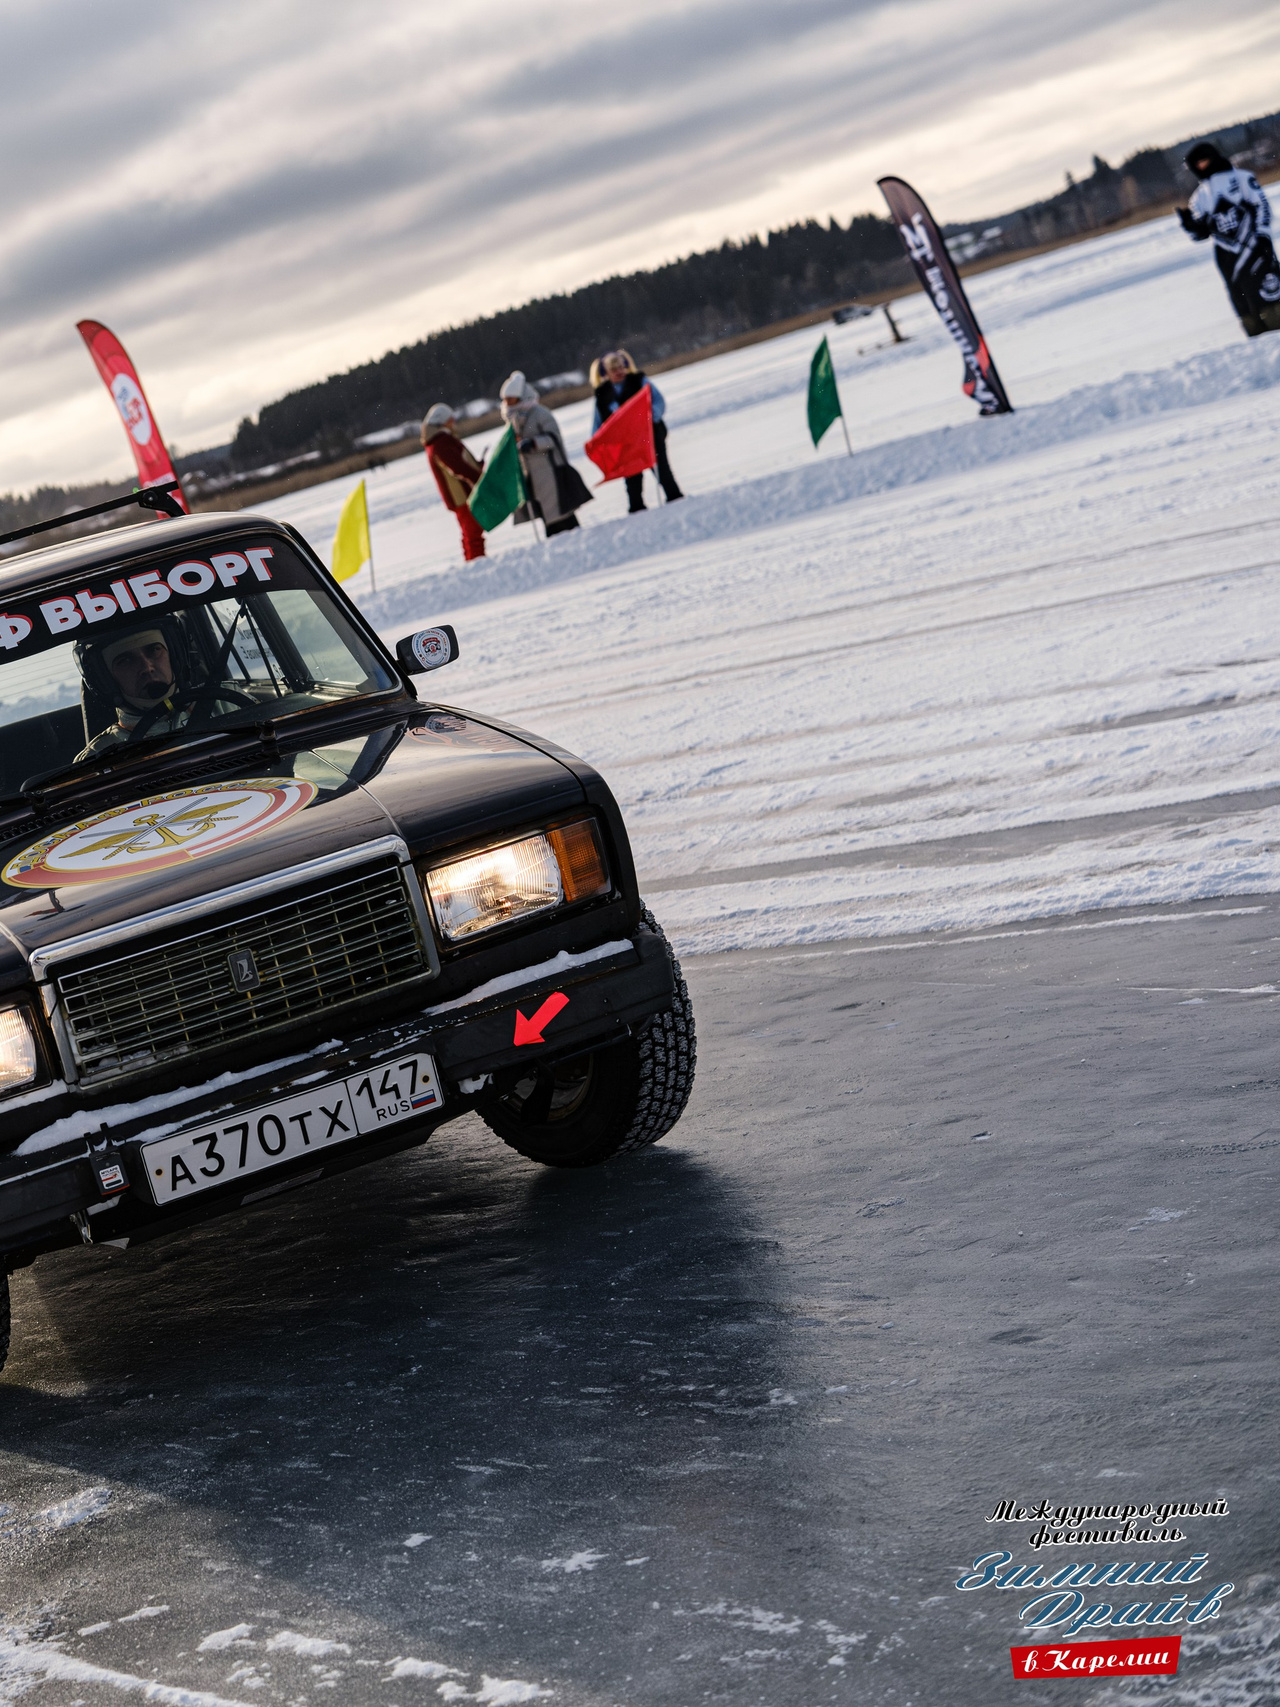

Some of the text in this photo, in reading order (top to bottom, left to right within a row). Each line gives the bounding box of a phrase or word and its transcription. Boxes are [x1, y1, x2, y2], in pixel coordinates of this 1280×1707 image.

[39, 546, 275, 634] ВЫБОРГ
[171, 1059, 418, 1191] А370ТХ 147
[376, 1100, 411, 1121] RUS
